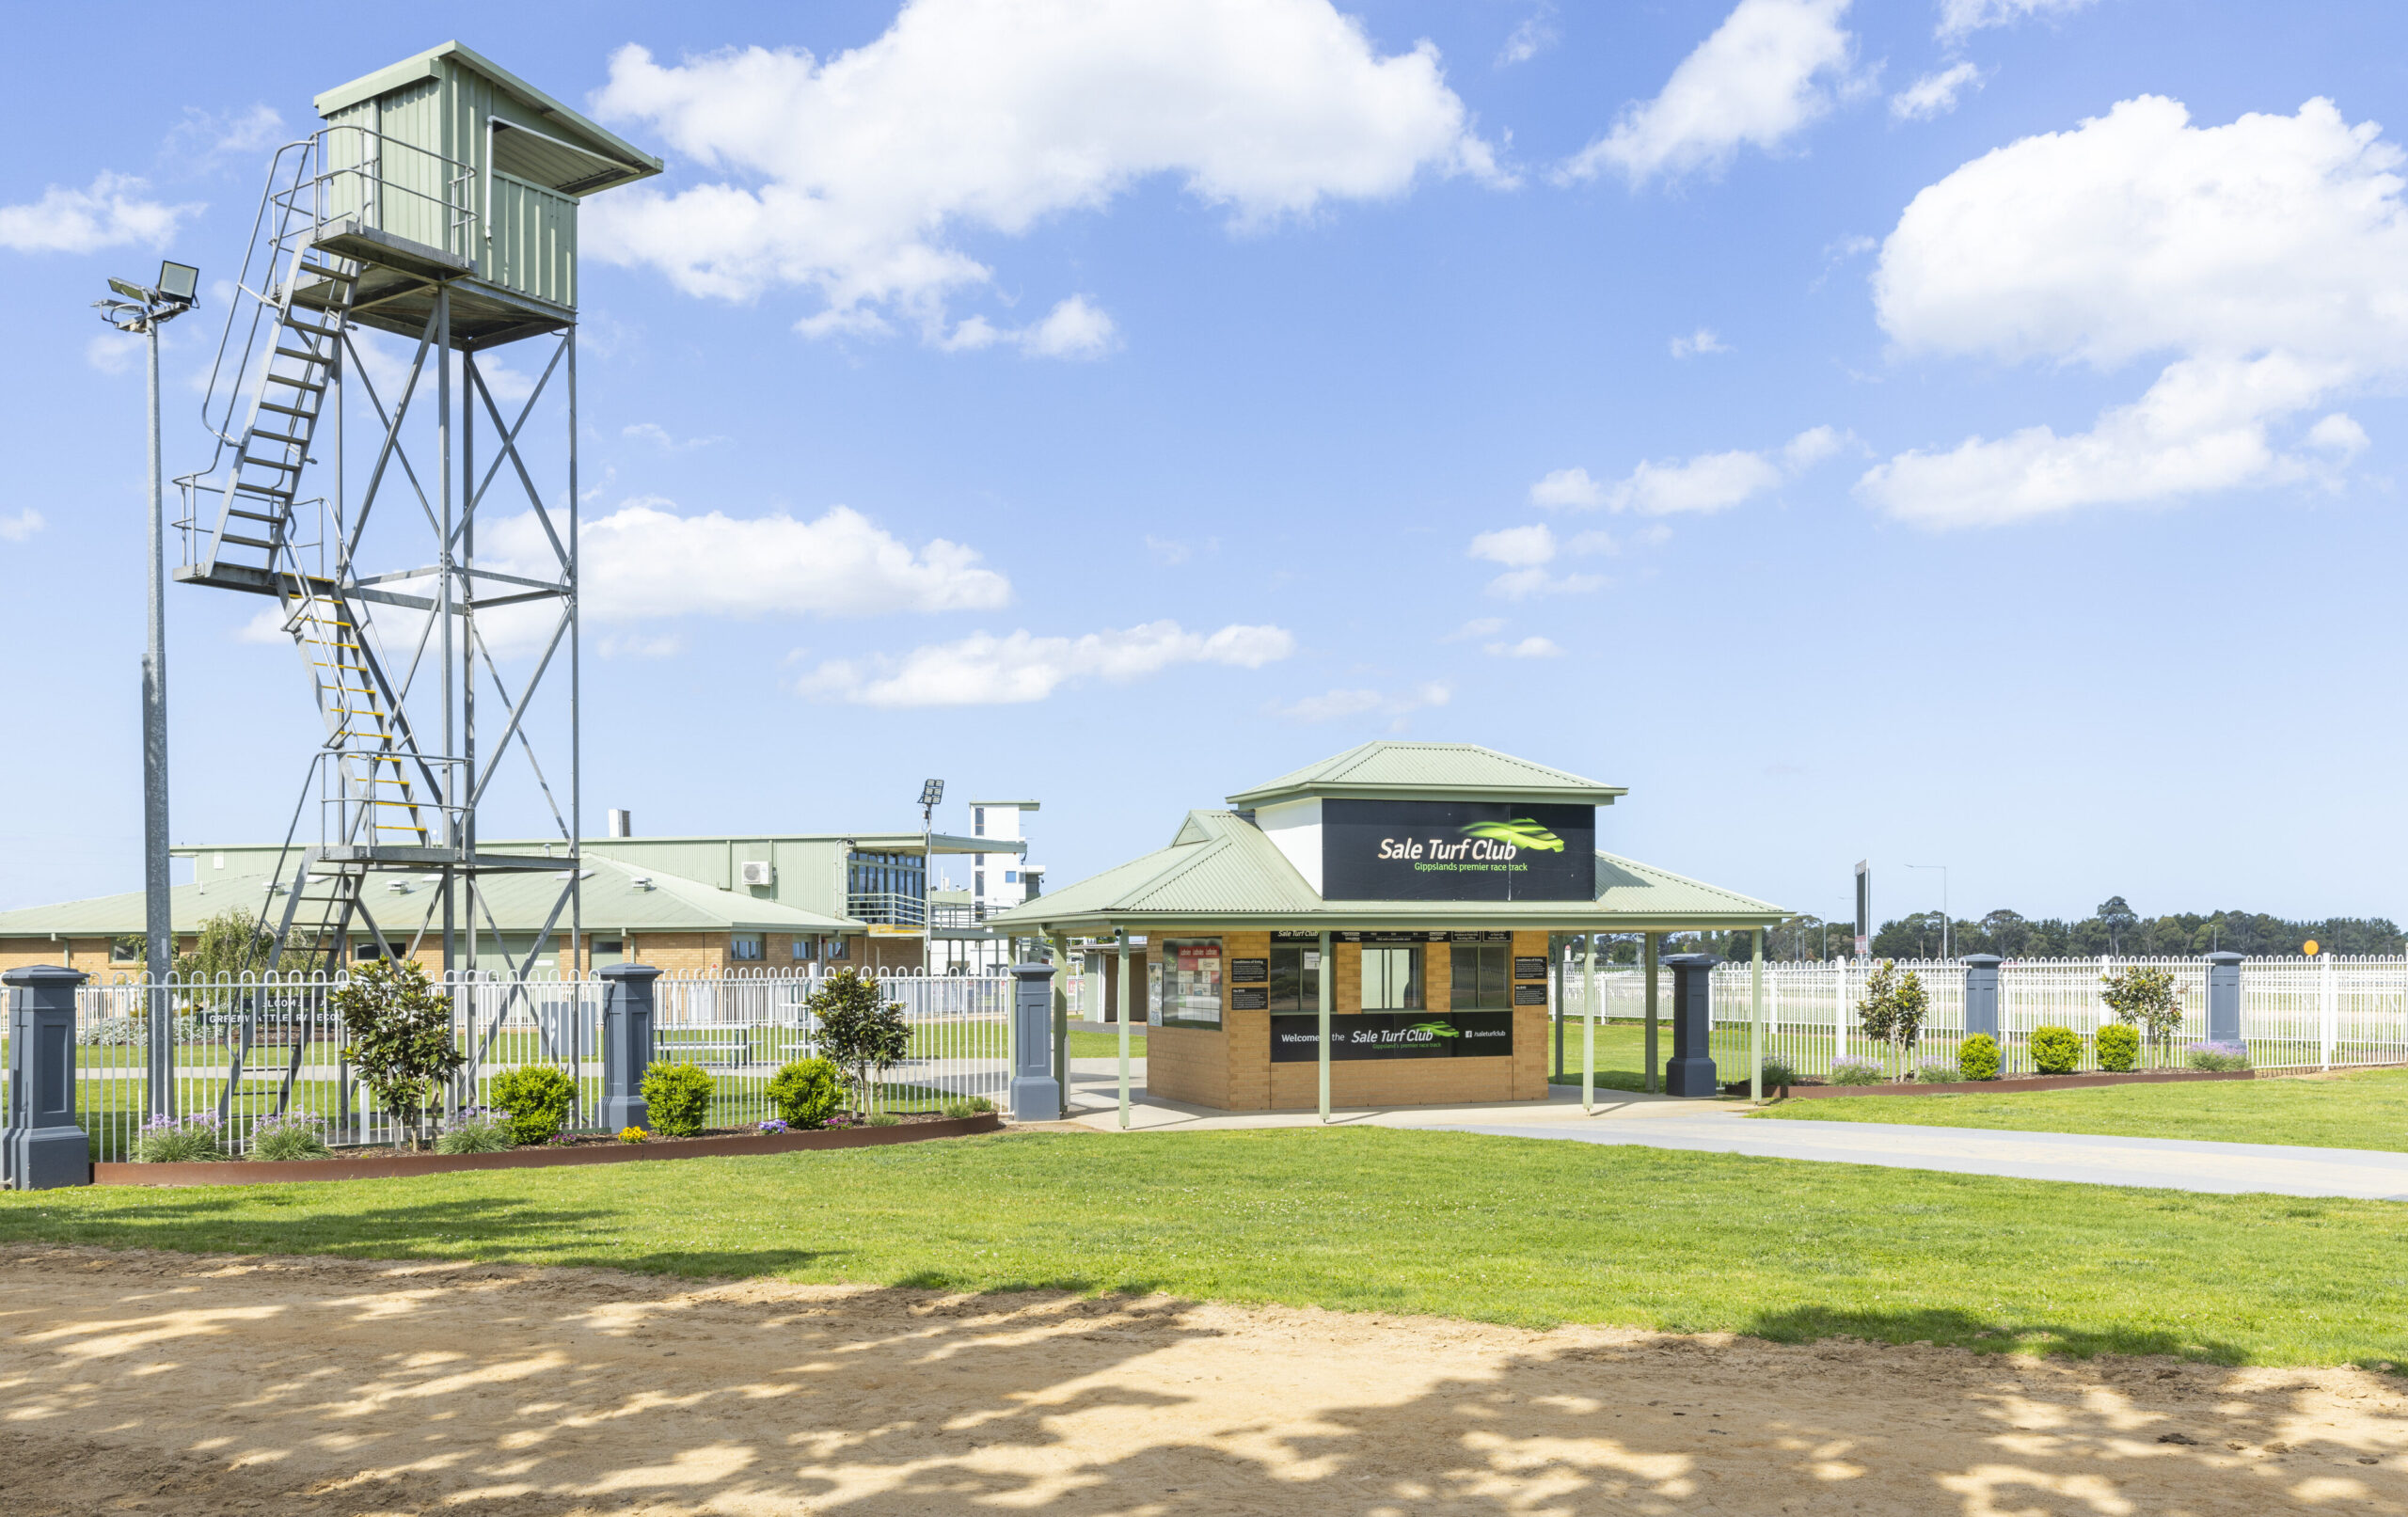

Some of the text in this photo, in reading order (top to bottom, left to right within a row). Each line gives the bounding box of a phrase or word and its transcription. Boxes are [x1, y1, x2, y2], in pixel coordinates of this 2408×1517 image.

[1377, 837, 1517, 861] Sale Turf Club
[1414, 862, 1458, 873] Gippslands
[1459, 863, 1489, 873] premier
[1281, 1033, 1345, 1042] Welcome the
[1351, 1029, 1434, 1043] Sale Turf Club
